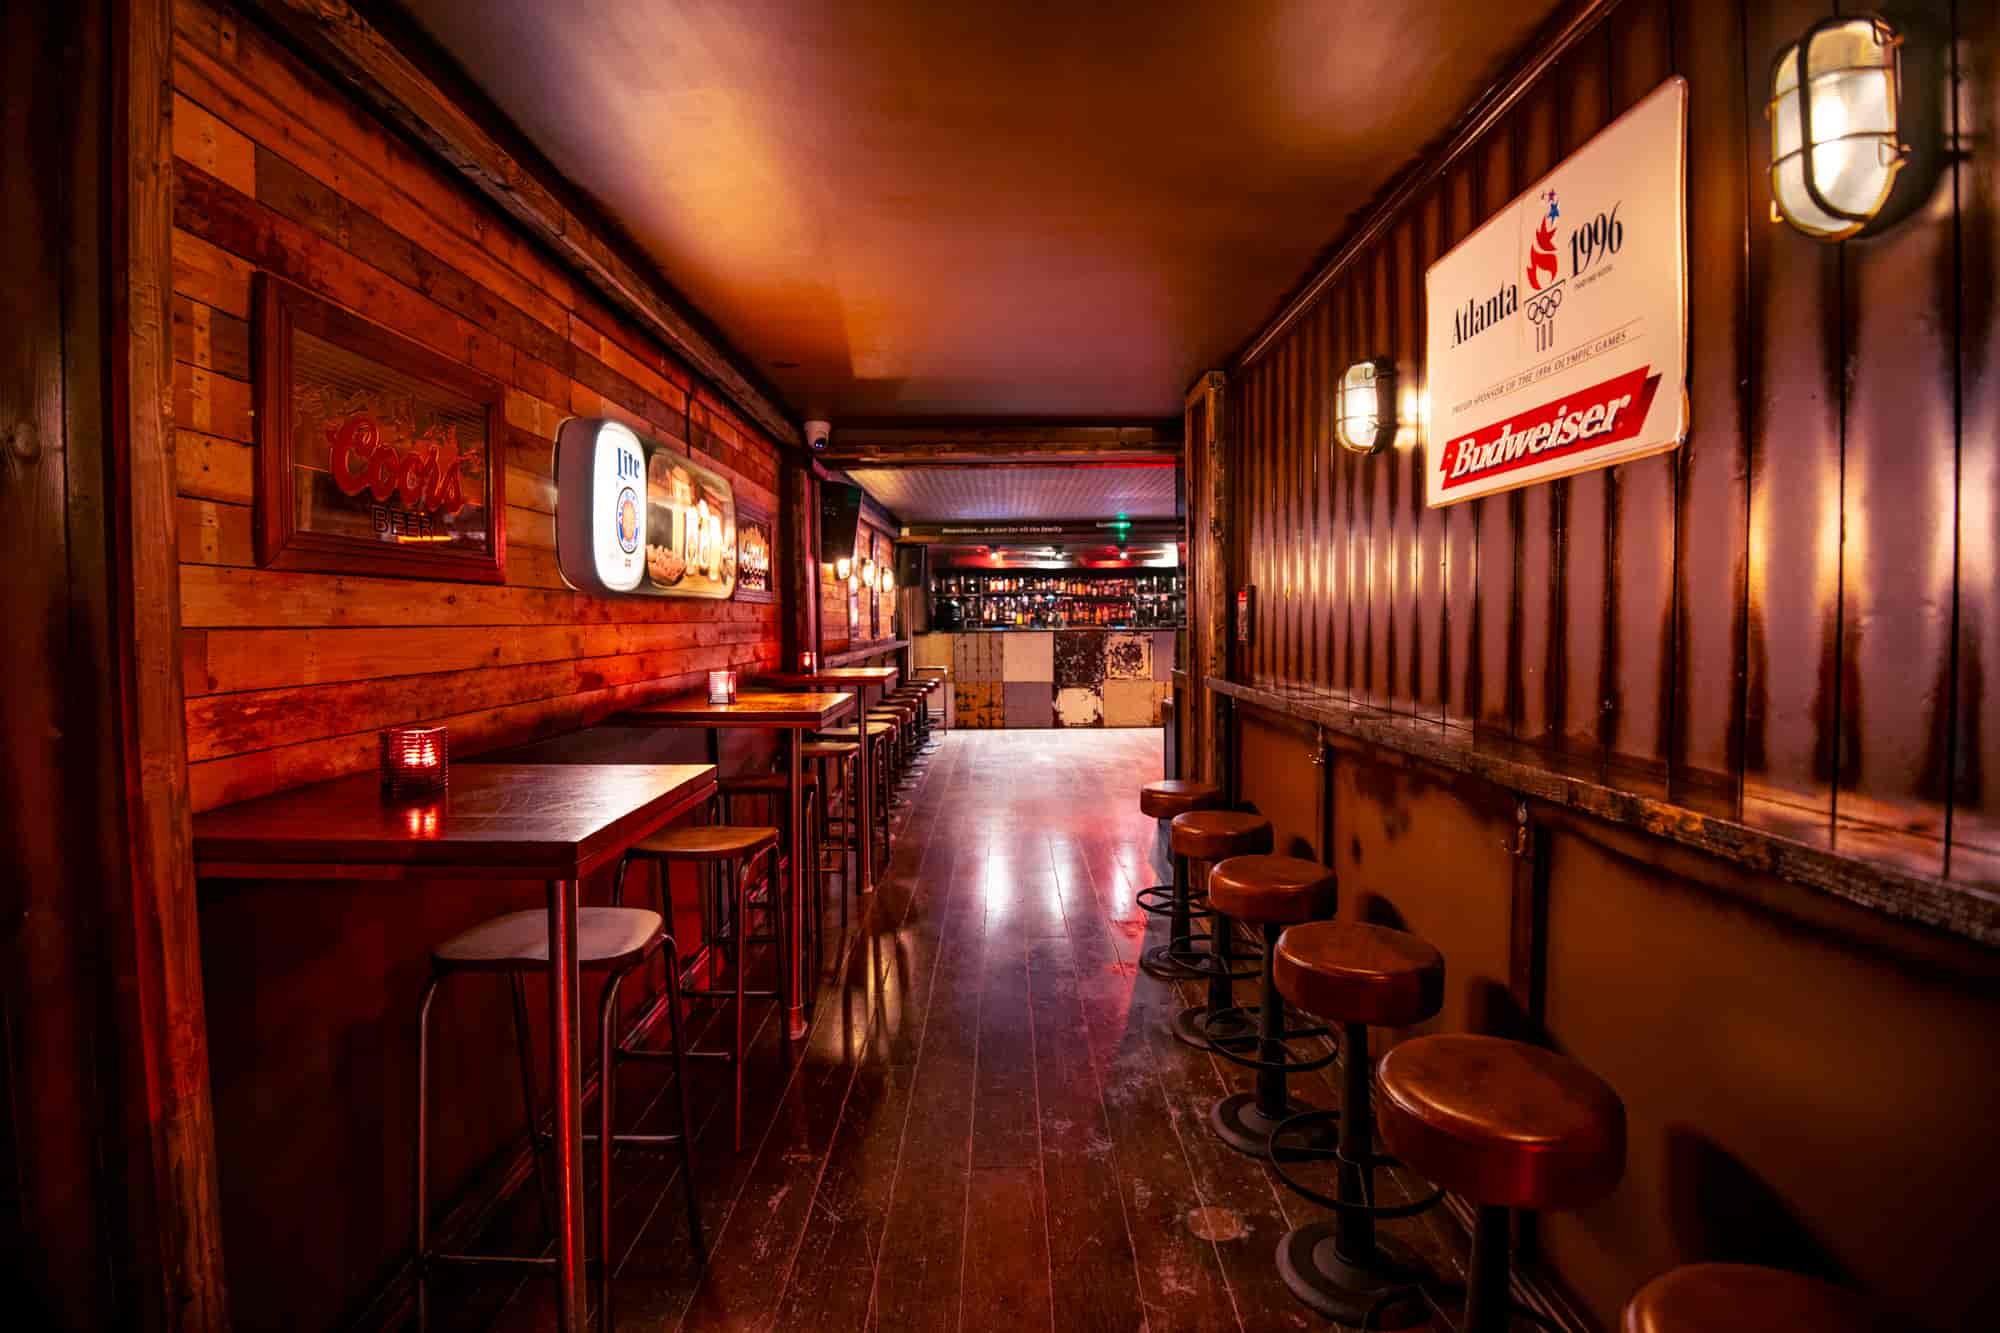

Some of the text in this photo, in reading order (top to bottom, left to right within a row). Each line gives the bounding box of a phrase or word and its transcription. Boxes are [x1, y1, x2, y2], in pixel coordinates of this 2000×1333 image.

[1450, 200, 1622, 349] Atlanta 1996
[1554, 346, 1592, 370] OLYMPIC
[1595, 330, 1627, 352] GAMES
[327, 415, 465, 516] Coors
[617, 447, 640, 481] Lite
[1451, 394, 1632, 478] Budweiser
[373, 507, 433, 538] BEER
